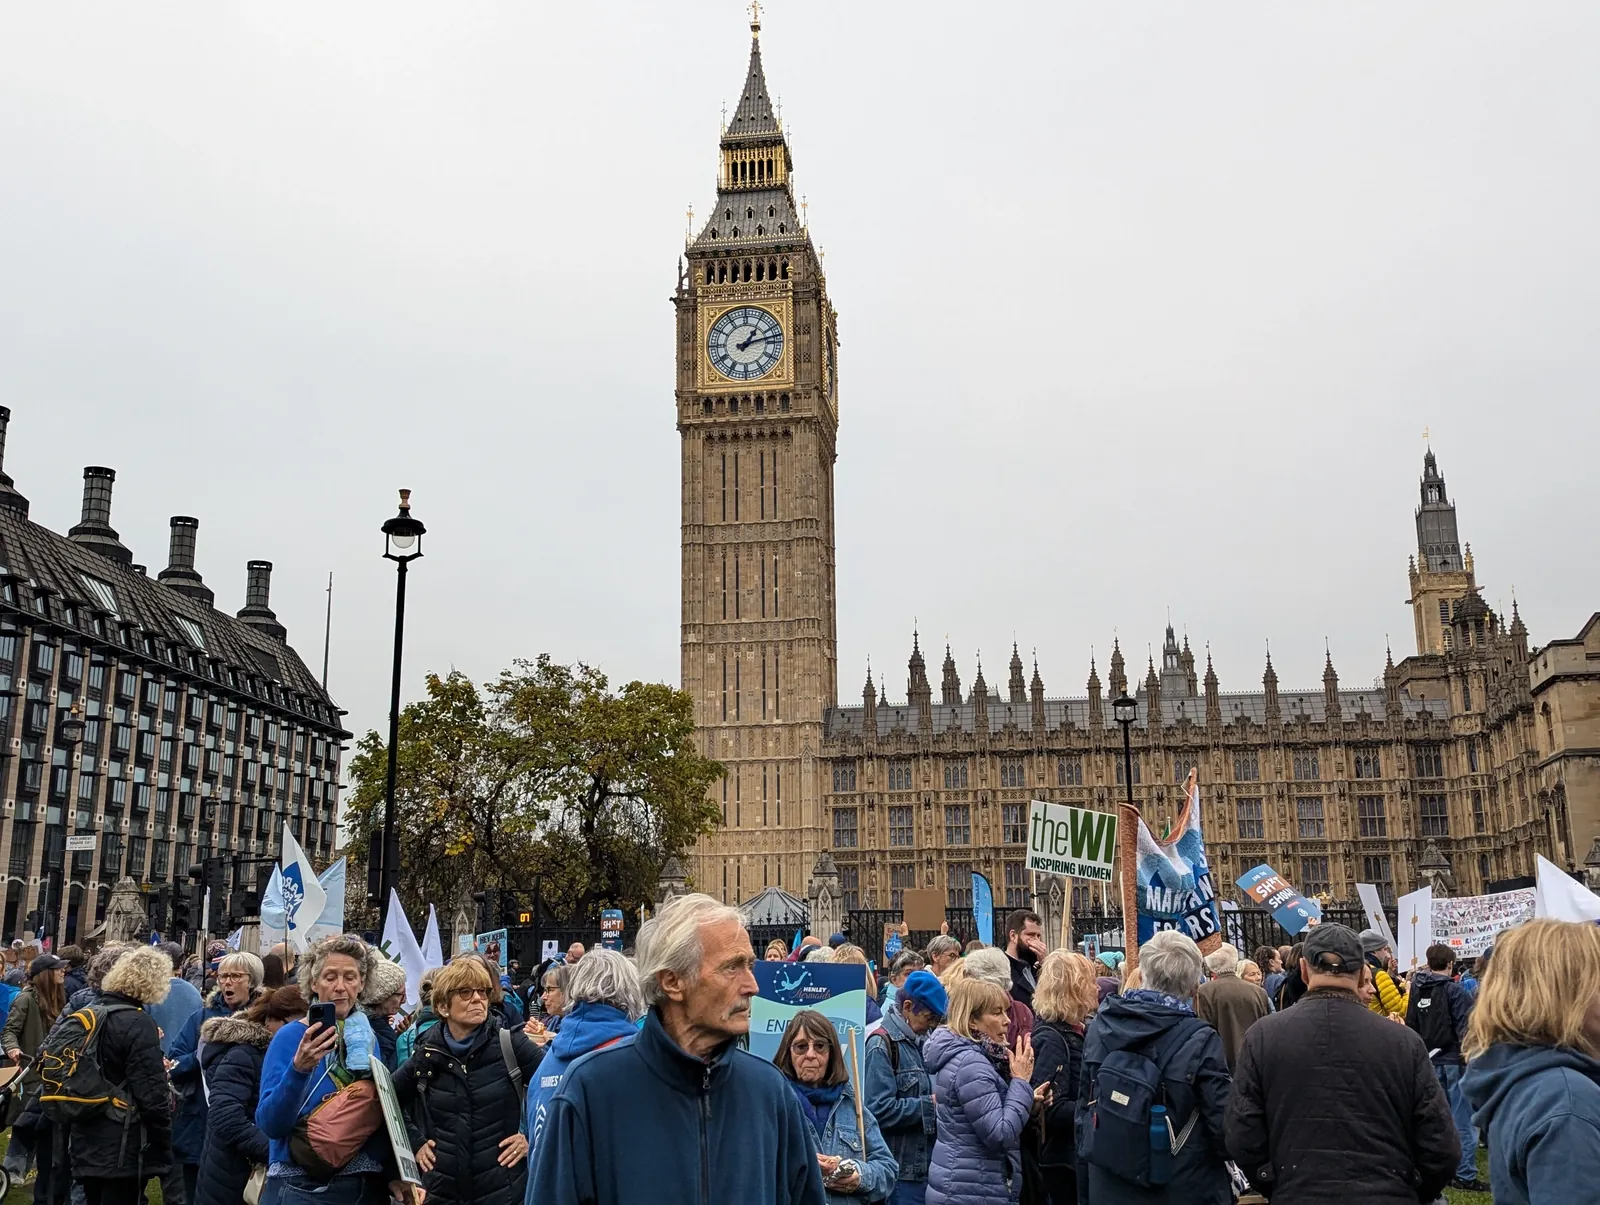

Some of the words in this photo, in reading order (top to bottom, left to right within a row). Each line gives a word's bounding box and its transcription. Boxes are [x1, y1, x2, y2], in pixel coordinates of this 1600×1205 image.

[1031, 856, 1076, 875] INSPIRING
[1078, 864, 1112, 881] WOMEN
[1268, 888, 1297, 909] SHOW!
[1493, 909, 1524, 920] SEWAGE
[602, 930, 620, 939] SHOW!
[1450, 926, 1474, 936] CLEAN
[1476, 920, 1511, 934] WATER
[838, 1021, 862, 1035] the
